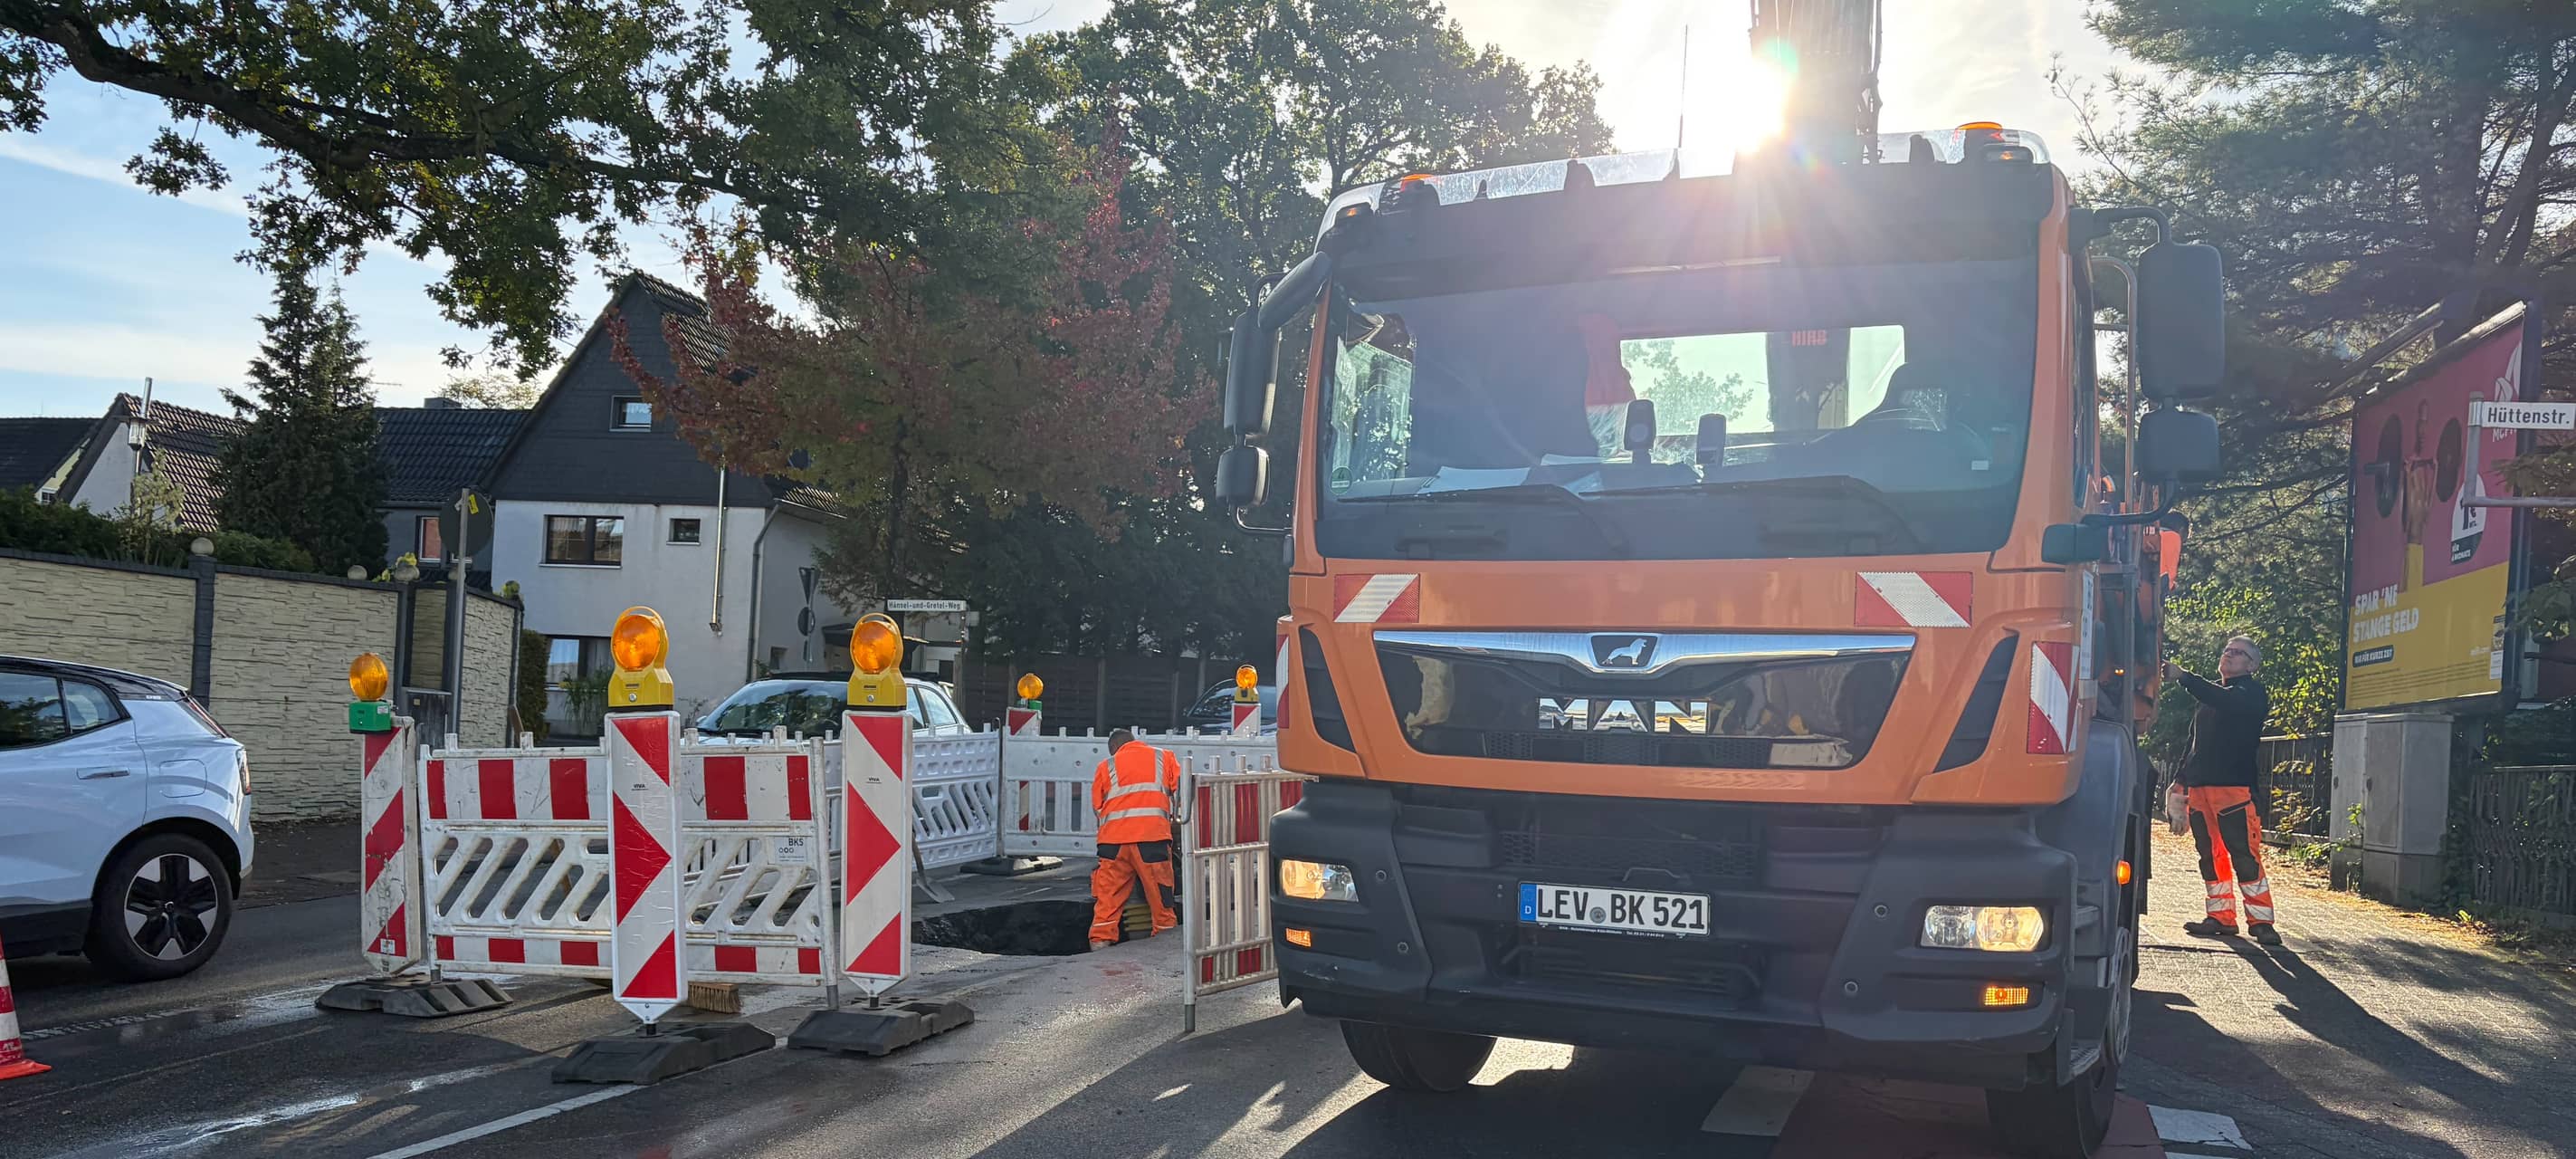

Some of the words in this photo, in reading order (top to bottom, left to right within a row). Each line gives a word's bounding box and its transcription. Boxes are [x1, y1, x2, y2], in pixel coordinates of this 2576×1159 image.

[2487, 407, 2571, 425] Hüttenstr.
[888, 601, 961, 610] Hänsel-und-Gretel-Weg
[2355, 591, 2380, 615] SPAR
[2353, 614, 2391, 642] STANGE
[2392, 608, 2419, 633] GELD
[1538, 697, 1710, 734] MAN
[788, 838, 804, 847] BKS
[1524, 905, 1532, 915] D
[1538, 888, 1589, 921] LEV
[1610, 894, 1646, 925] BK
[1653, 896, 1705, 930] 521
